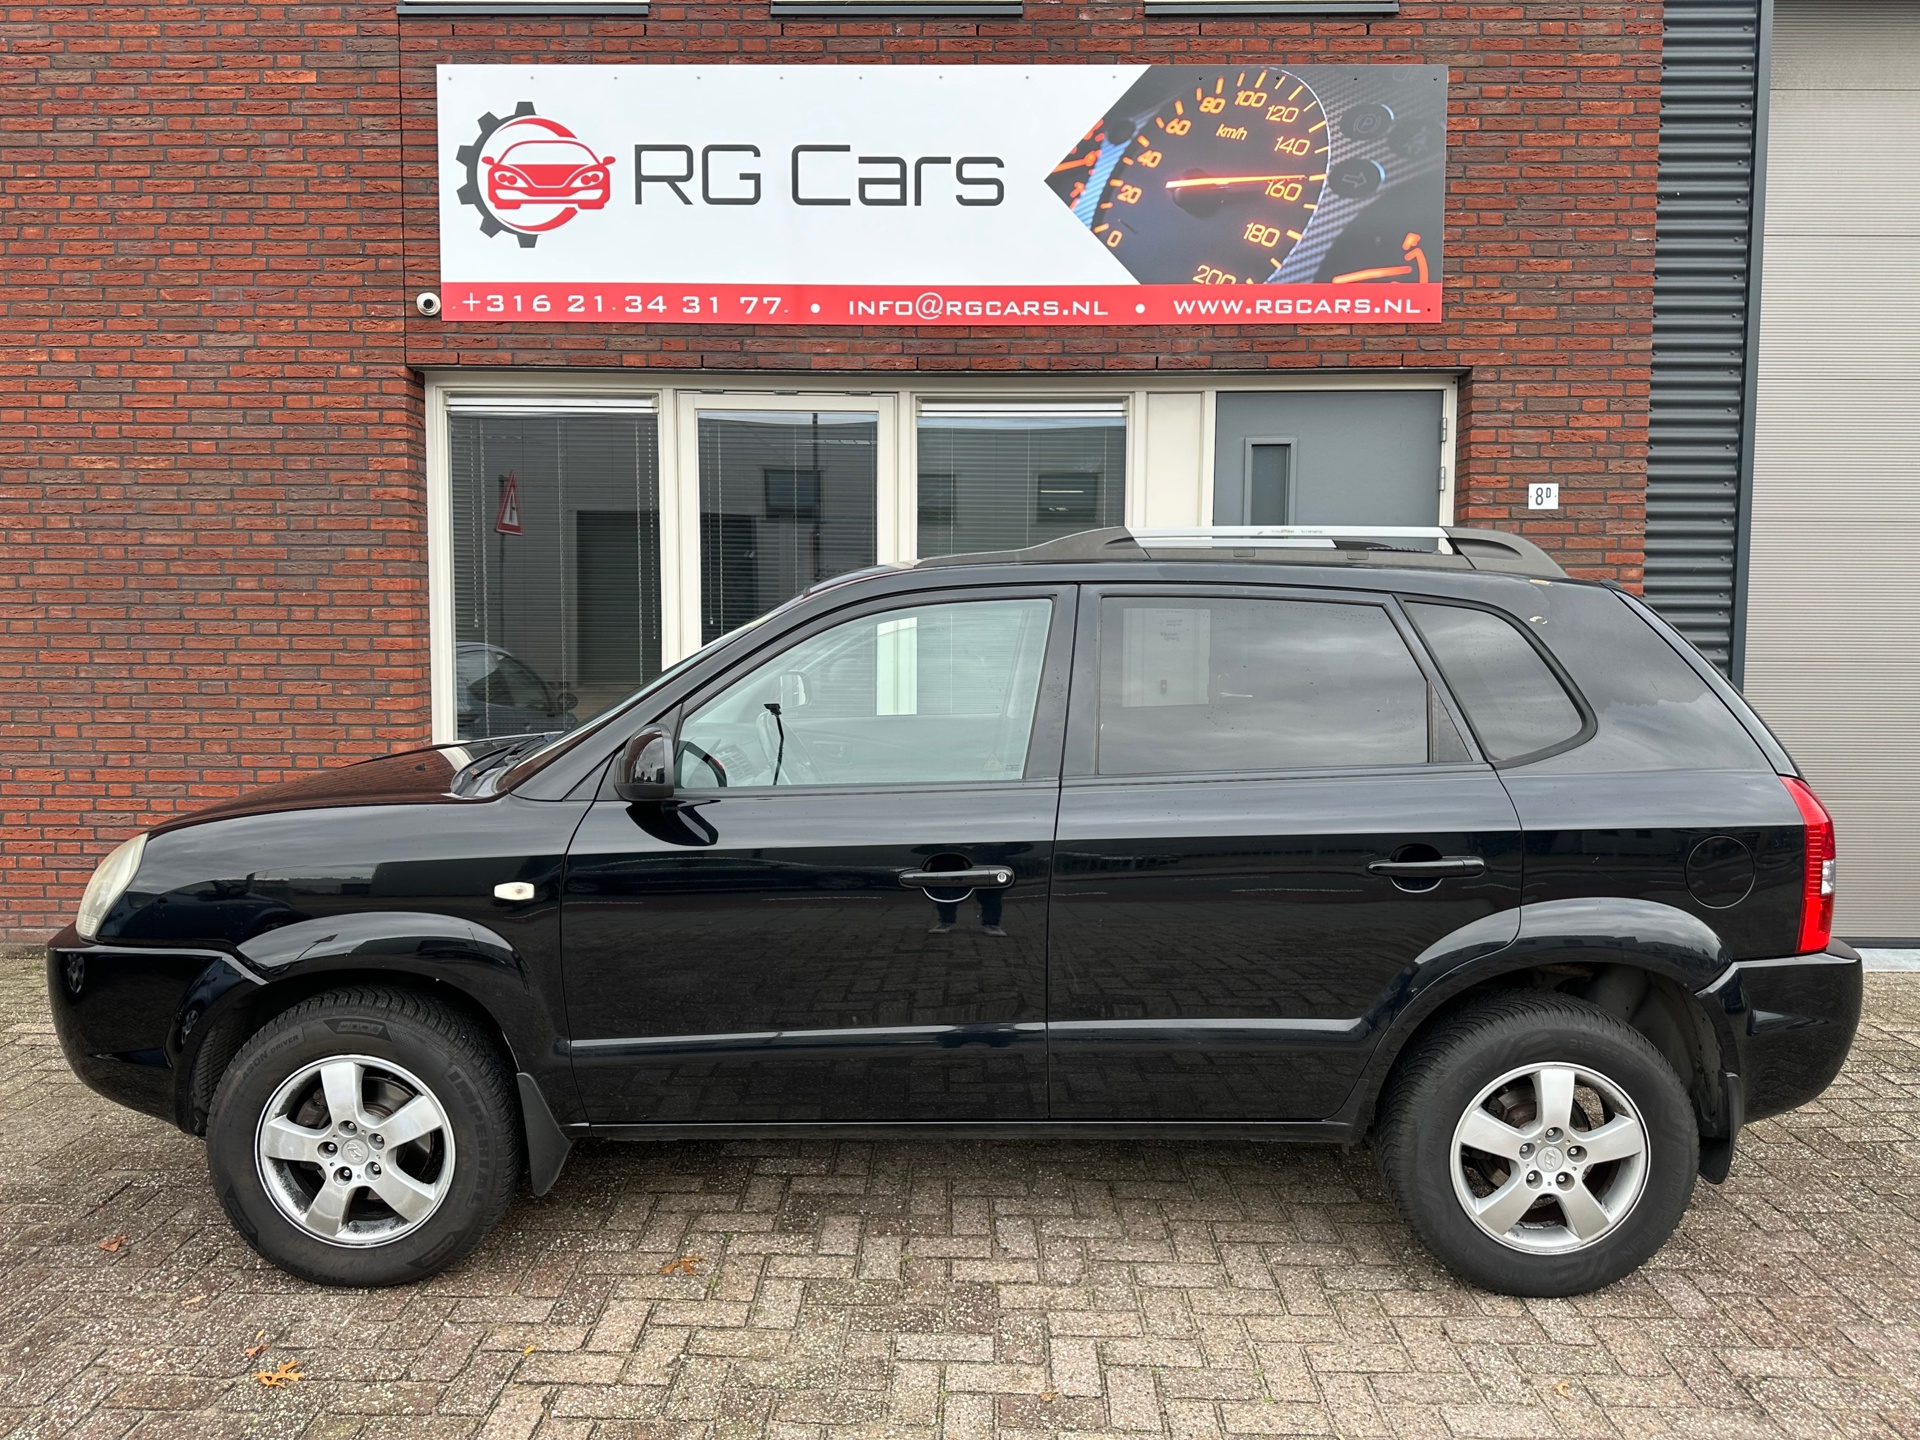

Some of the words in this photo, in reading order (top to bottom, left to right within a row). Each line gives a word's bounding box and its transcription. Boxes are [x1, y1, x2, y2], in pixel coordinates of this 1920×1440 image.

[1199, 97, 1226, 114] 80
[1235, 90, 1267, 107] 100
[1265, 104, 1299, 123] 120
[1165, 118, 1191, 136] 60
[1216, 123, 1248, 141] km/h
[1274, 136, 1310, 156] 140
[1137, 150, 1163, 168] 40
[634, 144, 762, 206] RG
[791, 144, 1005, 207] Cars
[1117, 184, 1143, 205] 20
[1264, 180, 1302, 202] 160
[1106, 230, 1123, 248] 0
[1243, 222, 1280, 248] 180
[462, 293, 551, 313] +316
[682, 295, 718, 314] 31
[849, 291, 1109, 321] INFO@RGCARS.NL
[1173, 298, 1421, 315] WWW.RGCARS.NL
[270, 1034, 299, 1054] DRIVER
[448, 1070, 490, 1205] IMPERIAL
